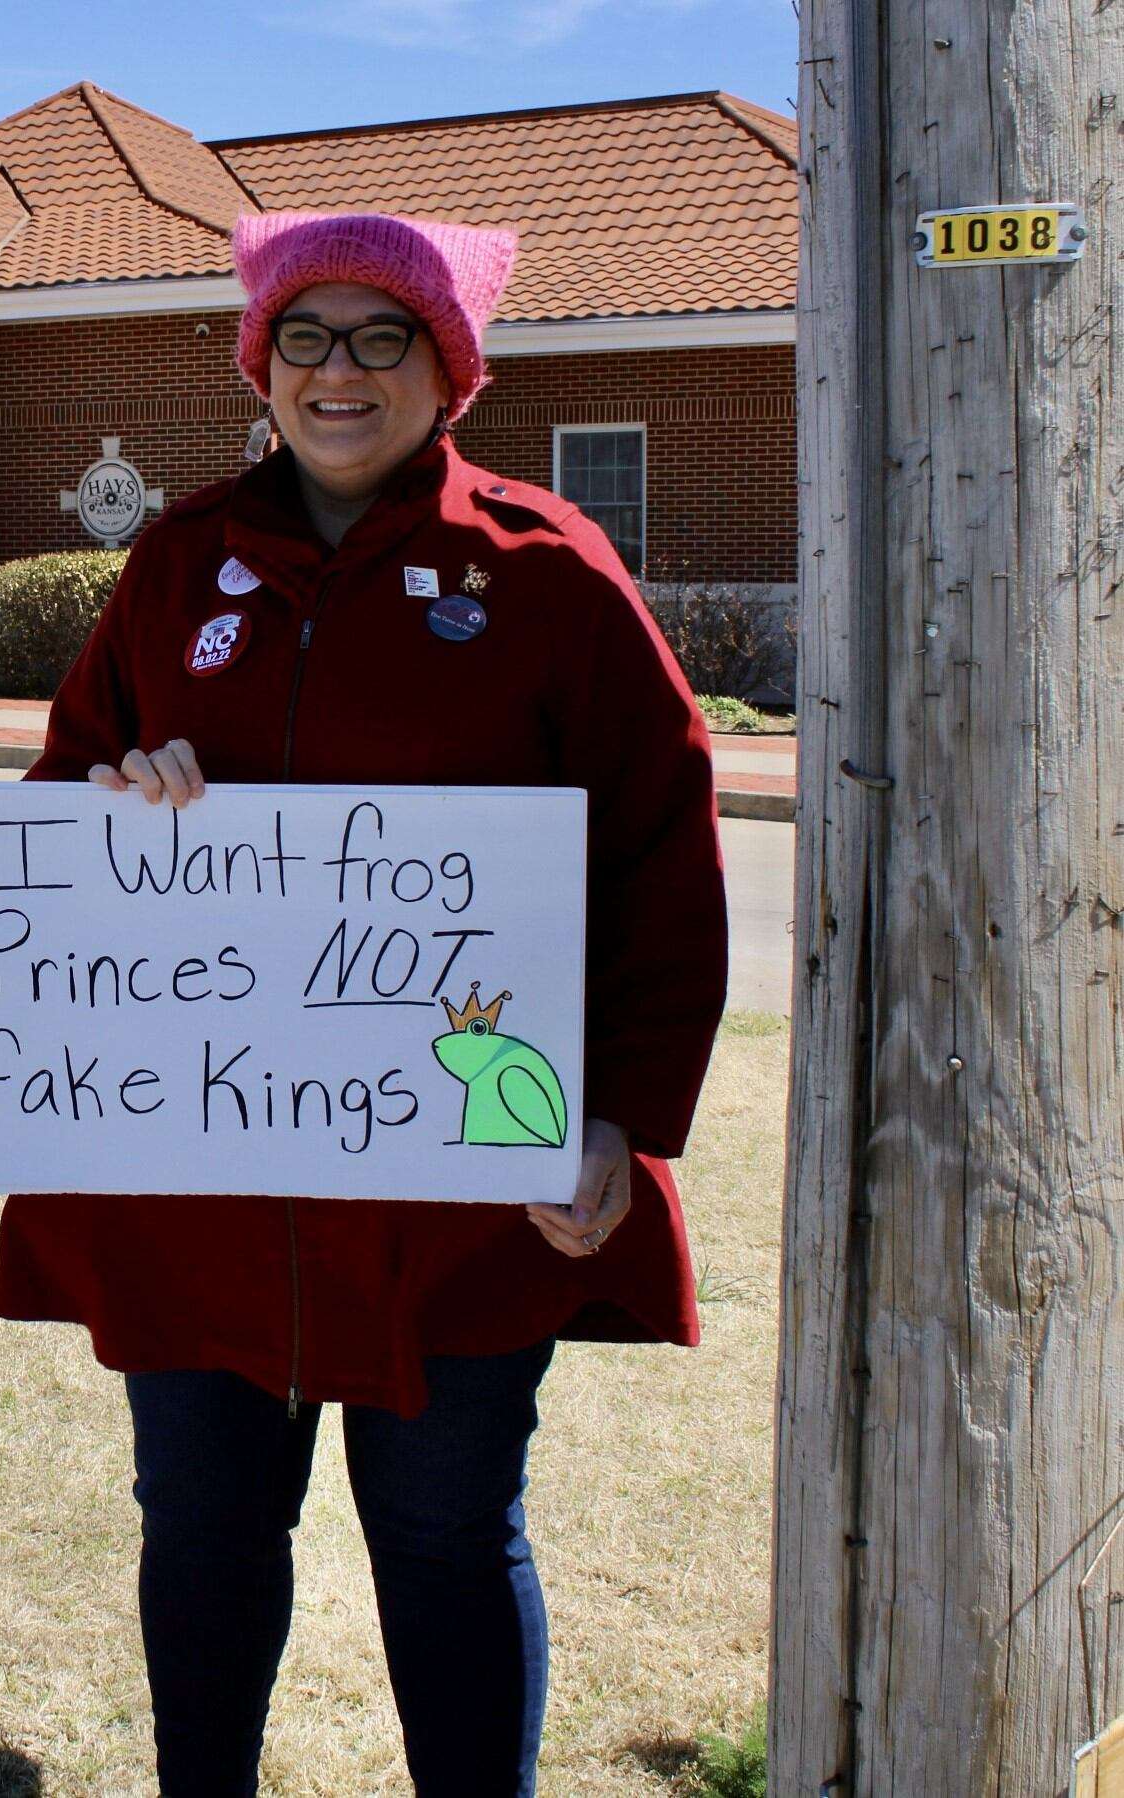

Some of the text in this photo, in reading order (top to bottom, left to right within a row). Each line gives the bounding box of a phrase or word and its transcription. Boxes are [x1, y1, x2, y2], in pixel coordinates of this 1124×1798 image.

[940, 216, 1052, 254] 1038
[88, 478, 136, 496] HAYS
[192, 649, 231, 668] 08.02.22
[194, 629, 237, 657] NO
[105, 806, 306, 898] Want
[322, 801, 476, 913] frog
[303, 918, 495, 1000] NOT
[202, 1040, 419, 1154] Kings
